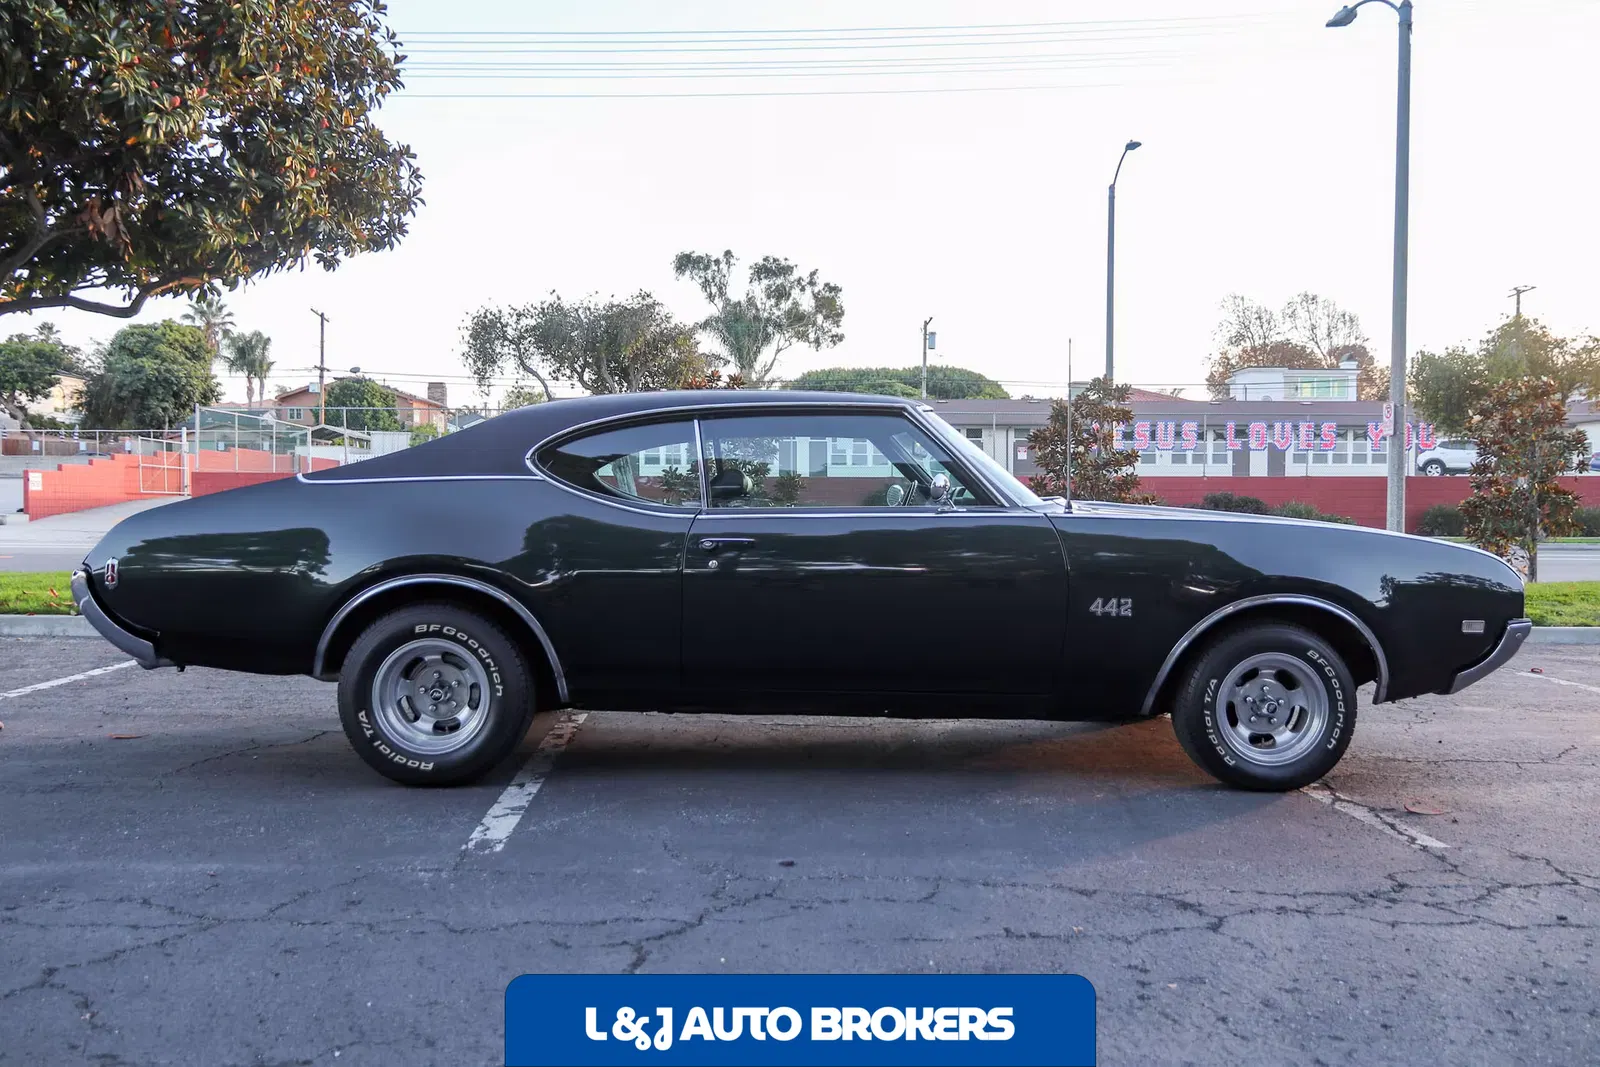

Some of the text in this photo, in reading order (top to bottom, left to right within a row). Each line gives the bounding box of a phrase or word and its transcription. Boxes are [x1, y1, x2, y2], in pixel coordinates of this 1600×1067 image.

[1088, 420, 1200, 451] ESUS
[1225, 420, 1337, 451] LOVES
[1089, 597, 1132, 617] 442
[415, 623, 504, 697] BFGoodrich
[1203, 678, 1237, 767] Radial T/A
[1306, 649, 1346, 750] BFGoodrich
[357, 709, 435, 772] Radial T/A
